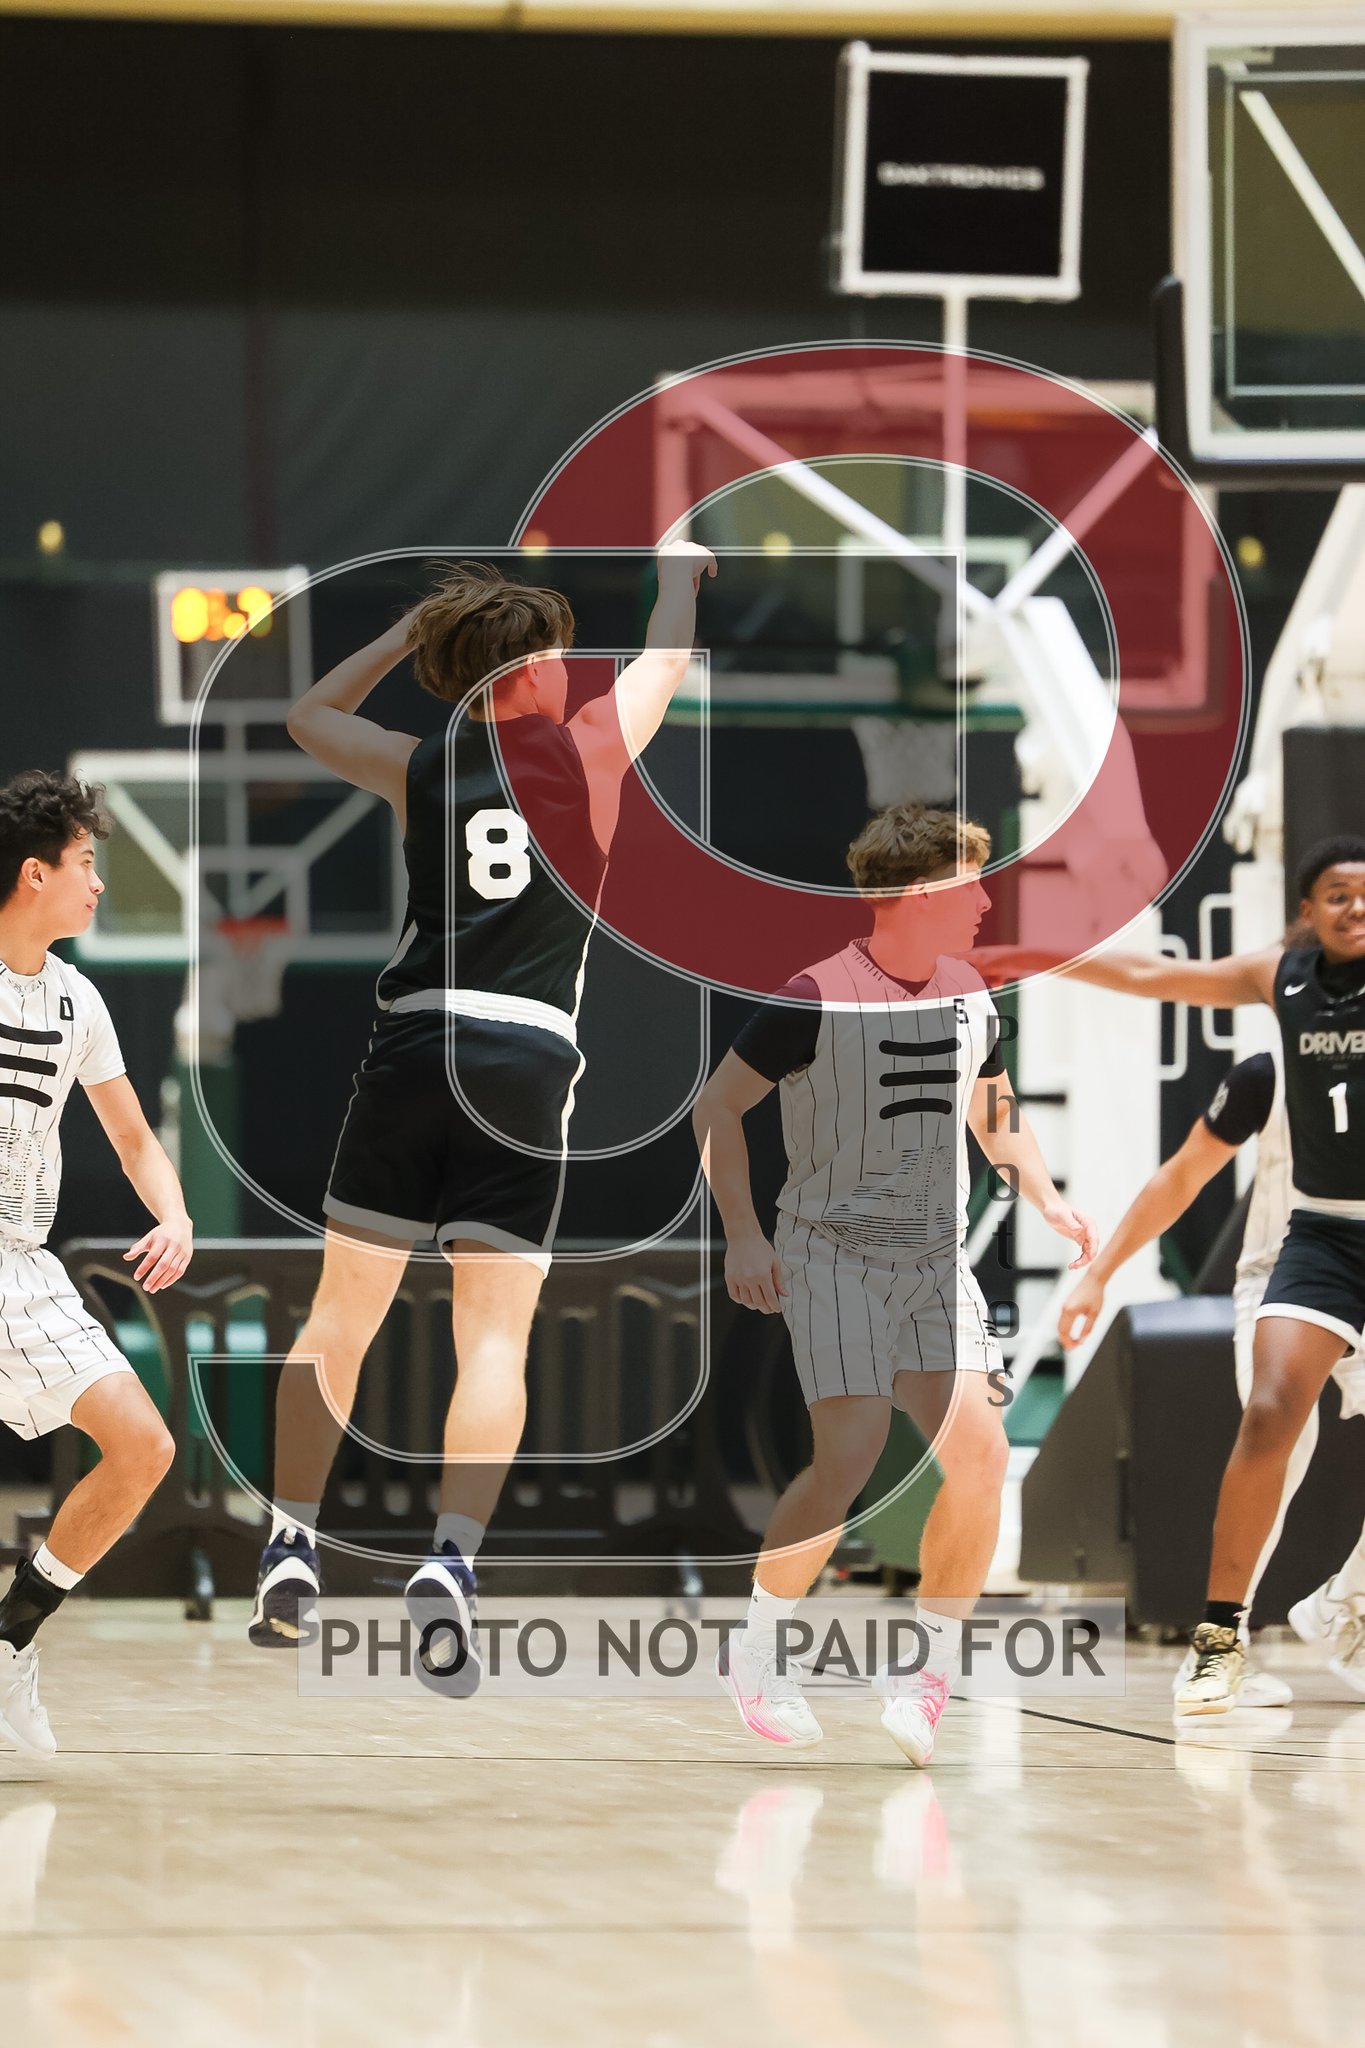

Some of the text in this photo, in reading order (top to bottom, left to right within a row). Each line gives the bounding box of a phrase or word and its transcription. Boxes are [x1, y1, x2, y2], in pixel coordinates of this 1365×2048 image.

[465, 808, 531, 900] 8
[953, 999, 969, 1024] 5
[1299, 1030, 1365, 1055] DRIVE
[1328, 1082, 1348, 1133] 1
